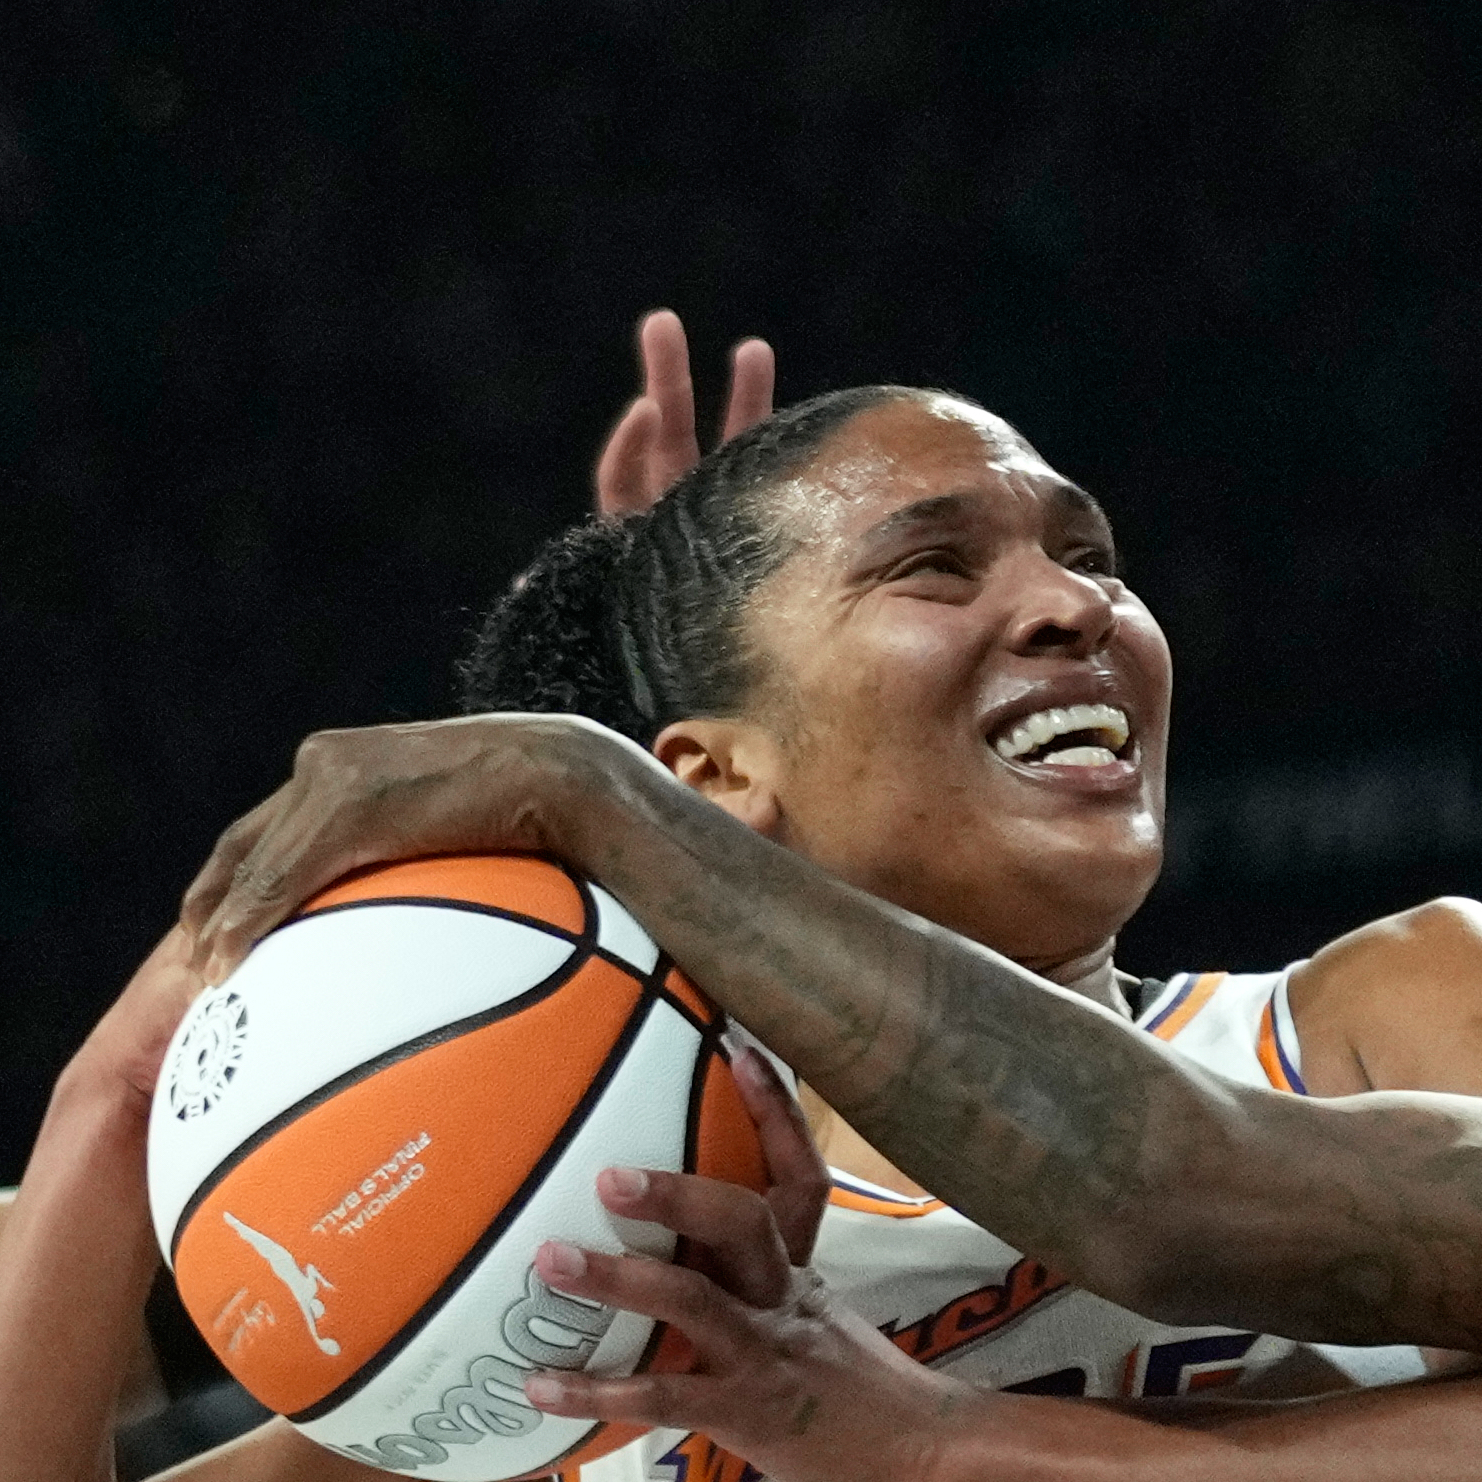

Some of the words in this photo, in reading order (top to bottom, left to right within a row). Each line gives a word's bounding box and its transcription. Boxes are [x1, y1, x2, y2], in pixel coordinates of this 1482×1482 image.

[360, 1131, 432, 1195] FINALS
[311, 1190, 362, 1235] BALL
[338, 1162, 425, 1235] OFFICIAL
